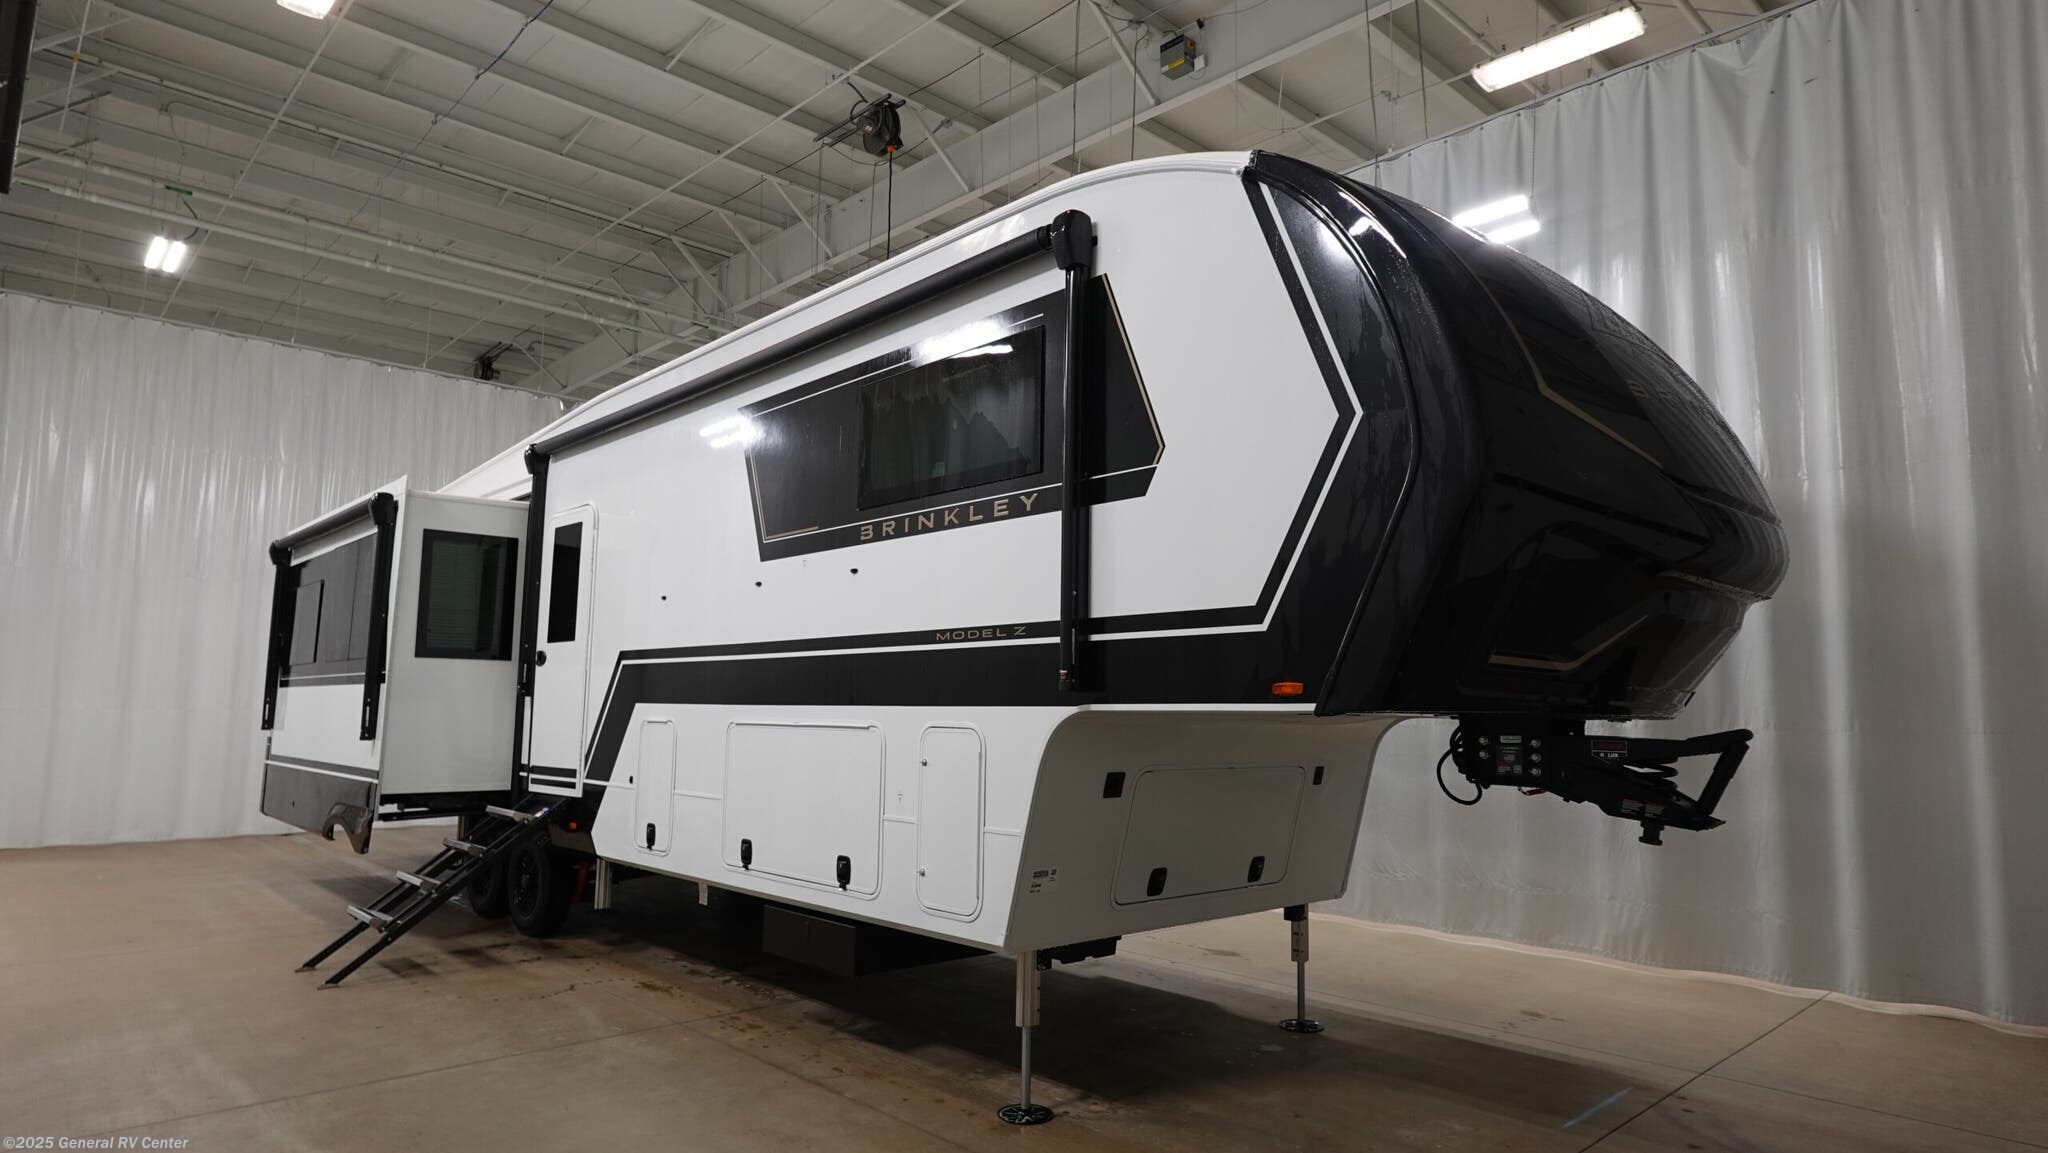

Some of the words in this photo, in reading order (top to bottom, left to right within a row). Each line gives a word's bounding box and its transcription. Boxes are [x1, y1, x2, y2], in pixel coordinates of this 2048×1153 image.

[860, 493, 1038, 541] BRINKLEY
[936, 628, 1007, 641] MODEL
[1013, 626, 1026, 636] Z
